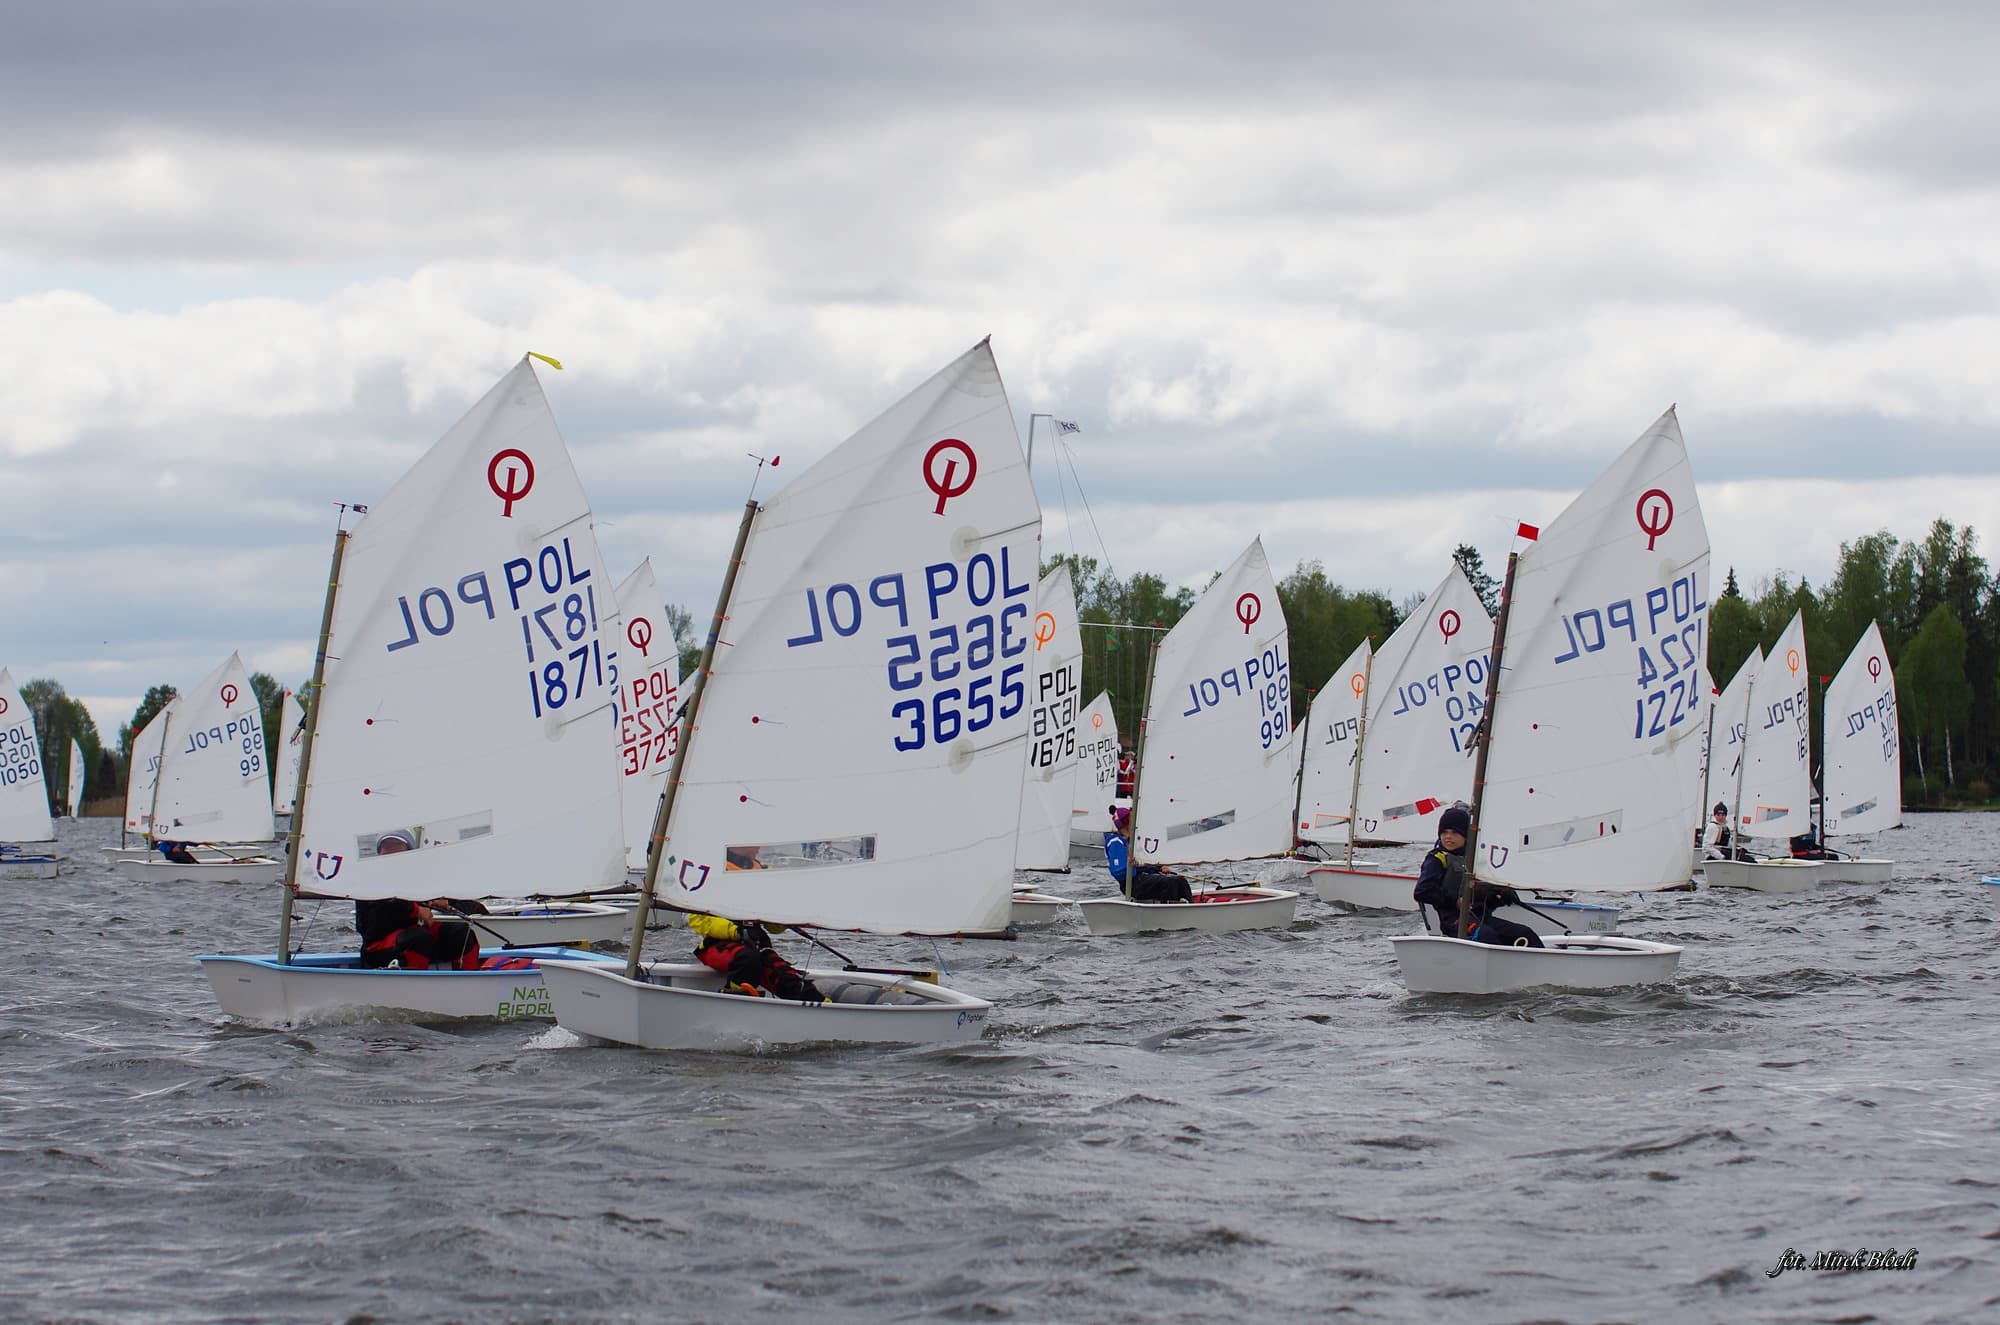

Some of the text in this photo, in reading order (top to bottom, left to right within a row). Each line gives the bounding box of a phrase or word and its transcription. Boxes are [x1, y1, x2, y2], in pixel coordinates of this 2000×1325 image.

[503, 537, 591, 610] POL
[925, 546, 1030, 620] POL
[1646, 572, 1706, 635] POL
[529, 639, 602, 718] 1871
[1040, 665, 1077, 702] POL
[1245, 644, 1287, 690] POL
[633, 668, 677, 708] POL
[891, 663, 1024, 752] 3655
[1635, 669, 1699, 739] 1224
[1877, 688, 1896, 718] POL
[0, 725, 32, 749] POL
[226, 714, 260, 741] POL
[1031, 727, 1075, 767] 1676
[1097, 738, 1116, 754] POL
[1261, 705, 1288, 749] 991
[240, 754, 260, 777] 99
[623, 726, 678, 776] 3723
[0, 759, 39, 786] 1050
[1096, 767, 1115, 786] 1474
